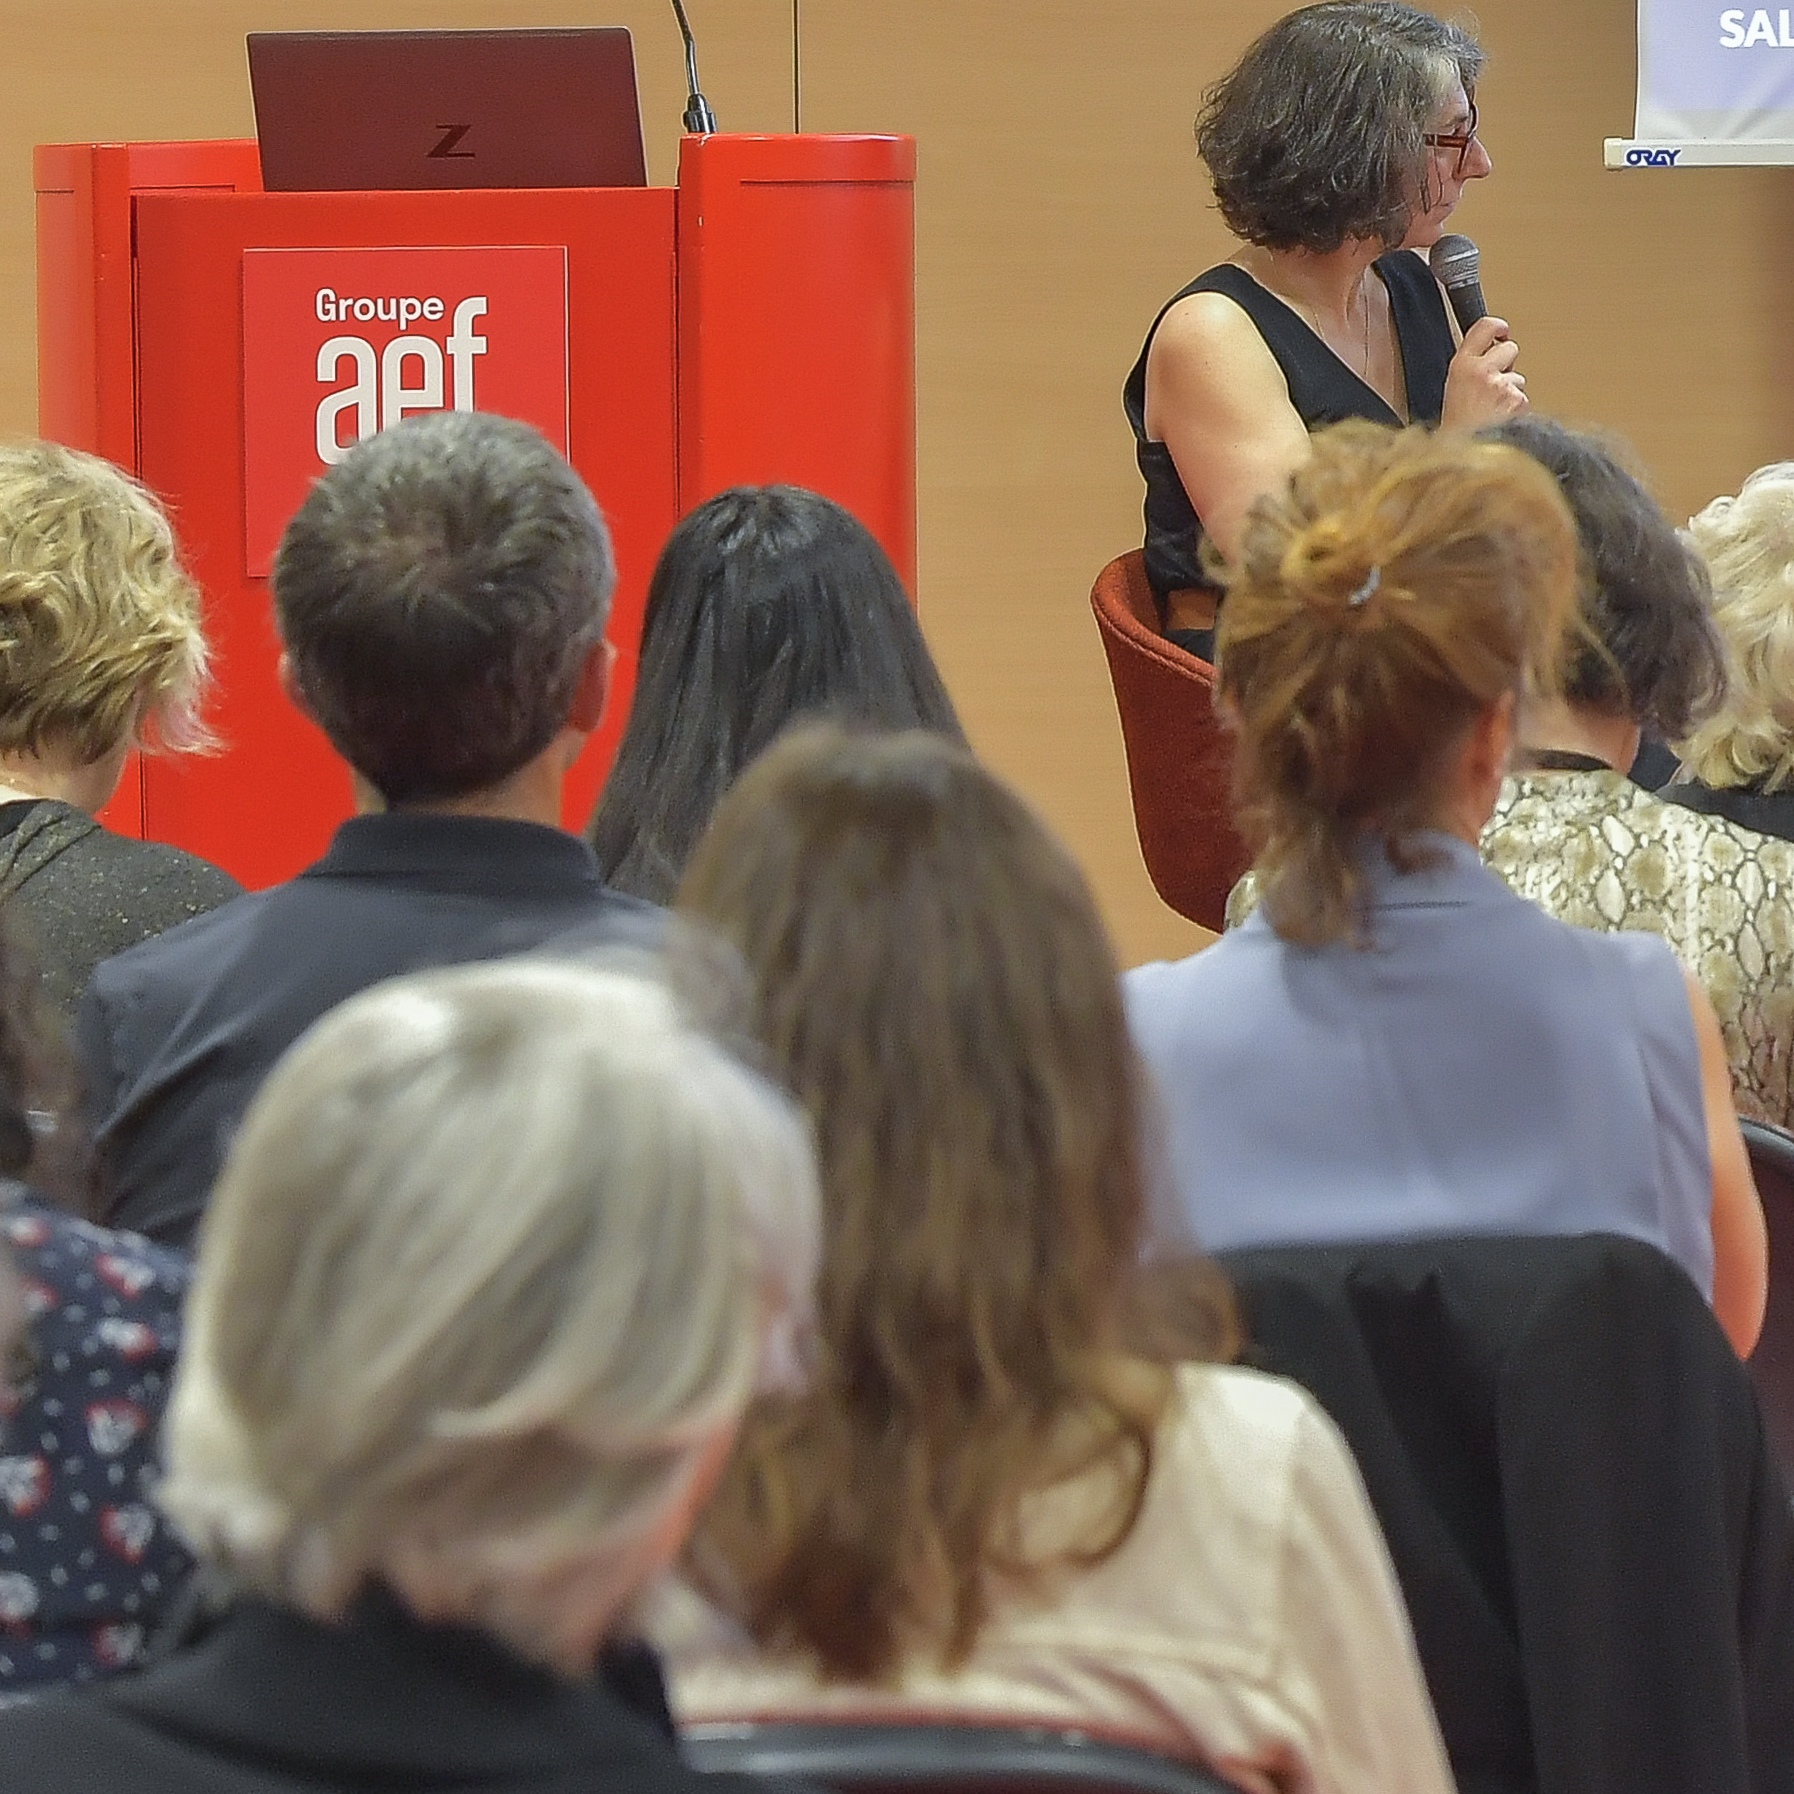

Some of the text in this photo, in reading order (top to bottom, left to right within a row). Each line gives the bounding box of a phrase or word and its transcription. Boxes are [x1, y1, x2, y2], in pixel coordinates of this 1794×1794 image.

[1626, 149, 1682, 166] ORAY
[315, 287, 445, 331] Groupe
[315, 295, 488, 466] aef
